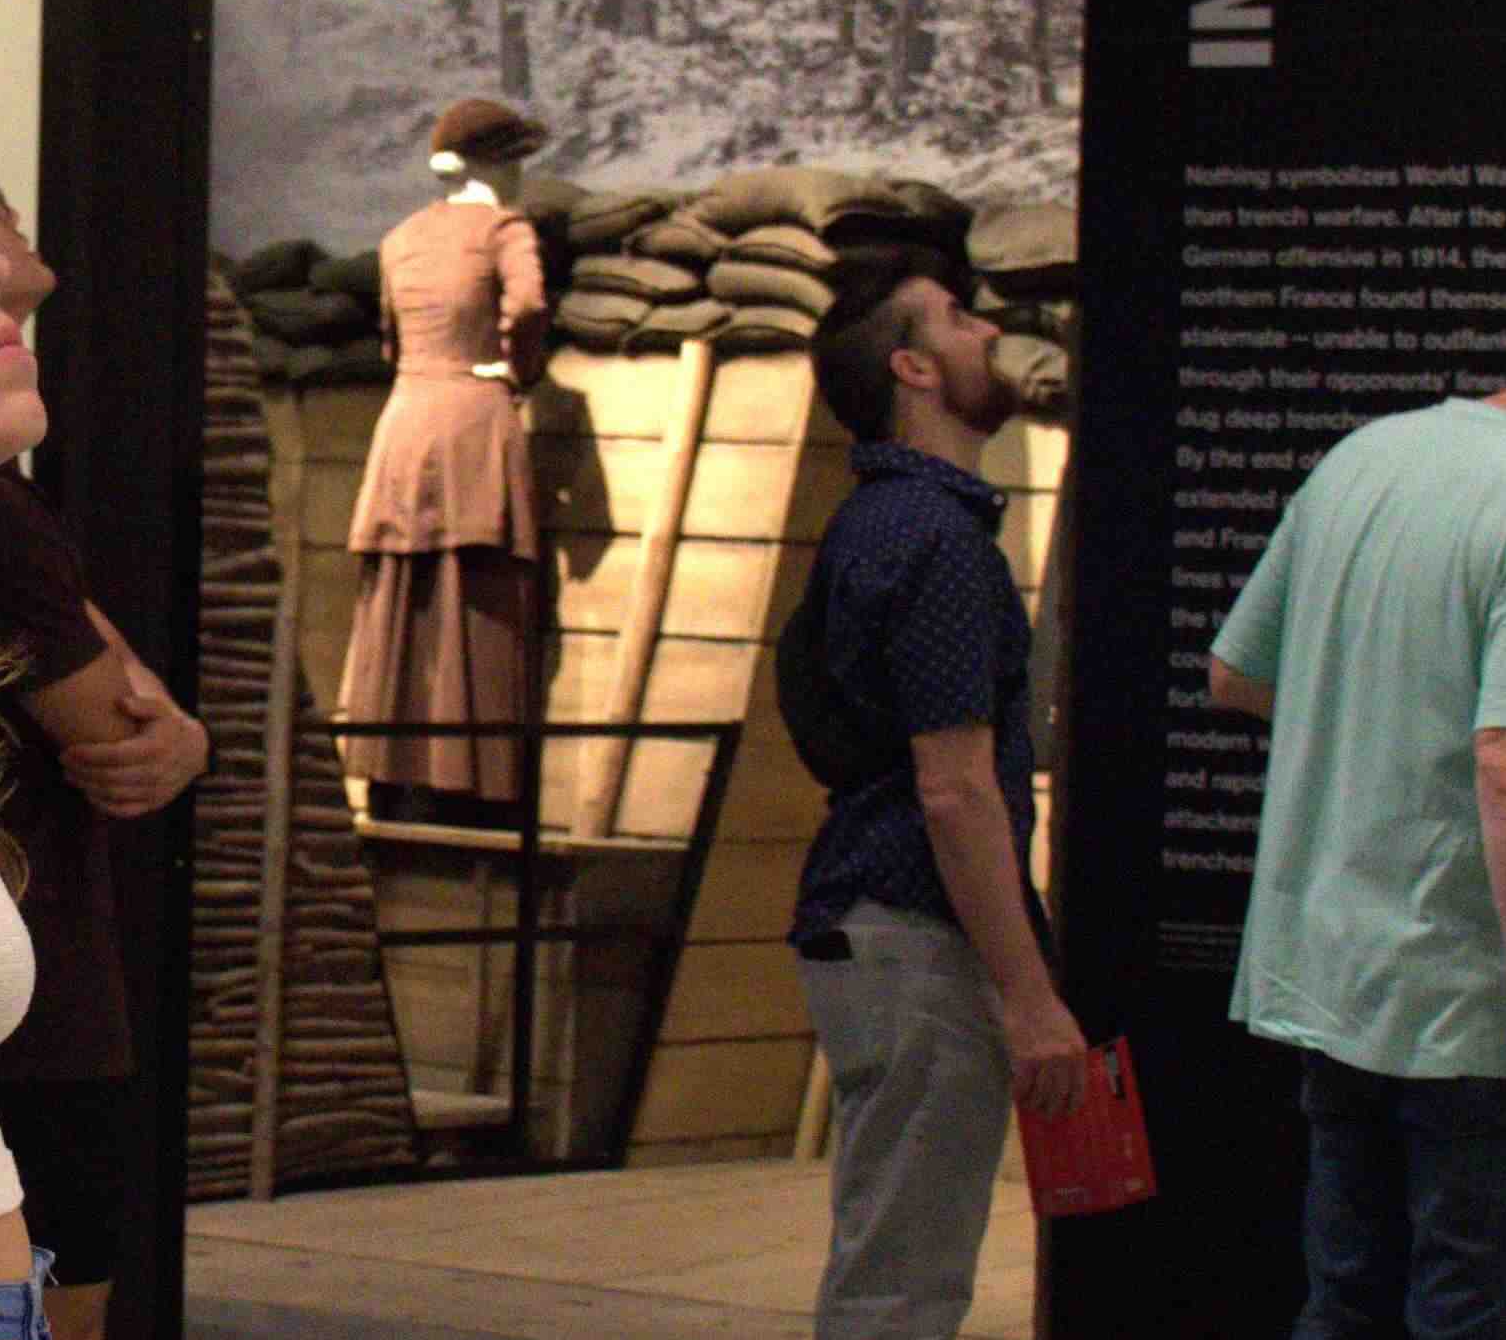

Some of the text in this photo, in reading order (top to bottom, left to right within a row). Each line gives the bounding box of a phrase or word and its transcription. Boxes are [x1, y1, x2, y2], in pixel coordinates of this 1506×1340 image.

[1184, 164, 1271, 190] Nothing
[1404, 165, 1470, 186] World
[1183, 206, 1235, 227] than
[1238, 206, 1309, 227] trench
[1406, 206, 1464, 227] After
[1468, 206, 1506, 227] the
[1380, 246, 1403, 267] in
[1279, 286, 1356, 309] France
[1359, 287, 1426, 308] found
[1312, 327, 1389, 349] unable
[1393, 328, 1419, 349] to
[1175, 407, 1220, 432] dug
[1224, 408, 1283, 433] deep
[1176, 445, 1205, 471] By
[1208, 446, 1245, 469] the
[1250, 447, 1295, 469] end
[1173, 526, 1216, 549] and
[1166, 729, 1252, 752] modern
[1164, 768, 1208, 791] and
